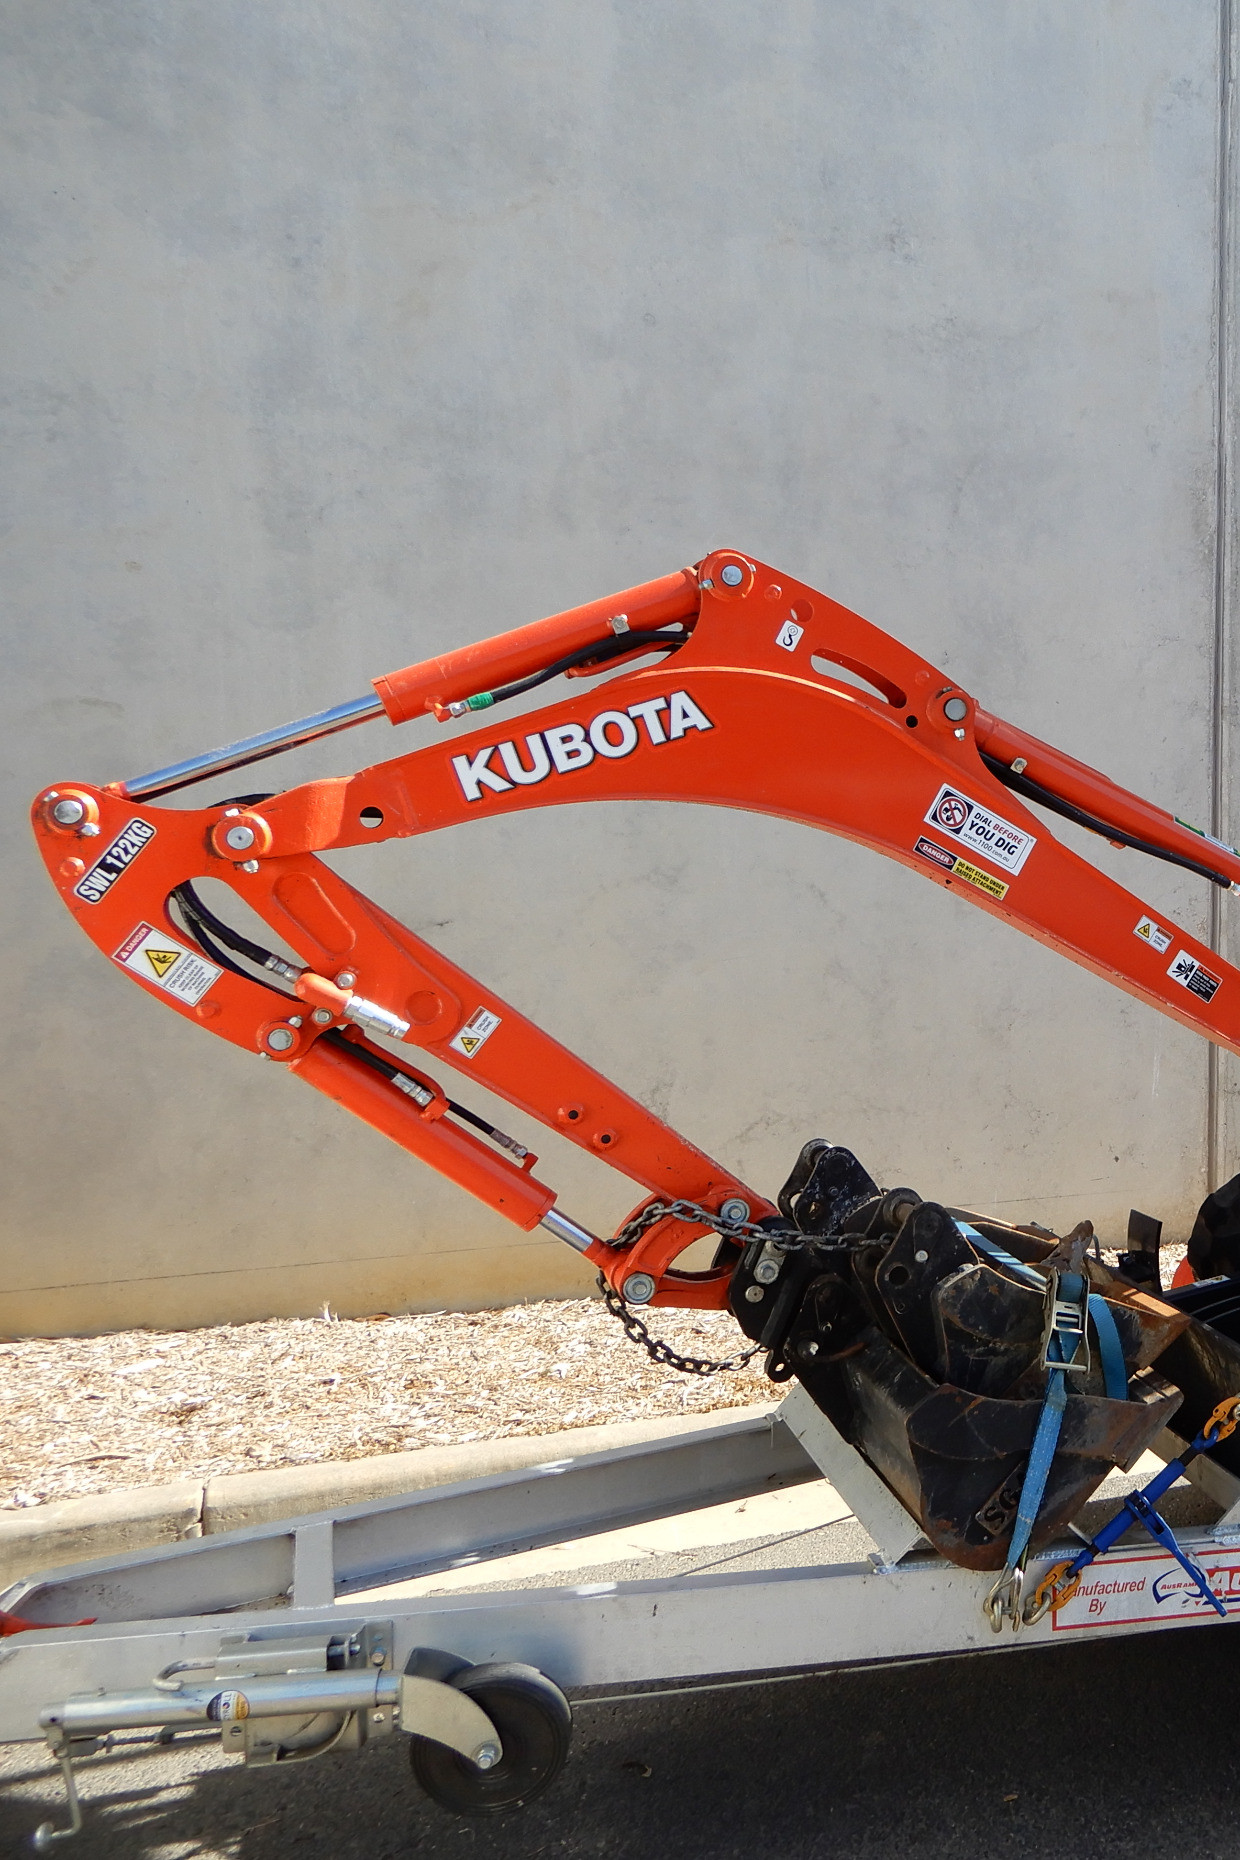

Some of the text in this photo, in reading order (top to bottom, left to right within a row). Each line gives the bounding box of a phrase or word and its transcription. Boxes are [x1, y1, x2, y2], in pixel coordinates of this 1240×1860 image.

[452, 689, 714, 802] KUBOTA
[969, 819, 1018, 856] YOU DIG
[974, 812, 1024, 845] DIAL BEFORE
[78, 821, 153, 901] SWL 122KG
[922, 844, 950, 864] DANGER
[957, 861, 965, 869] DO
[975, 871, 990, 884] STAND
[972, 876, 1002, 896] ATTACHMENT
[125, 927, 149, 952] DANGER
[168, 970, 185, 988] CRUSH
[1072, 1577, 1147, 1597] nufactured
[1088, 1598, 1107, 1616] By
